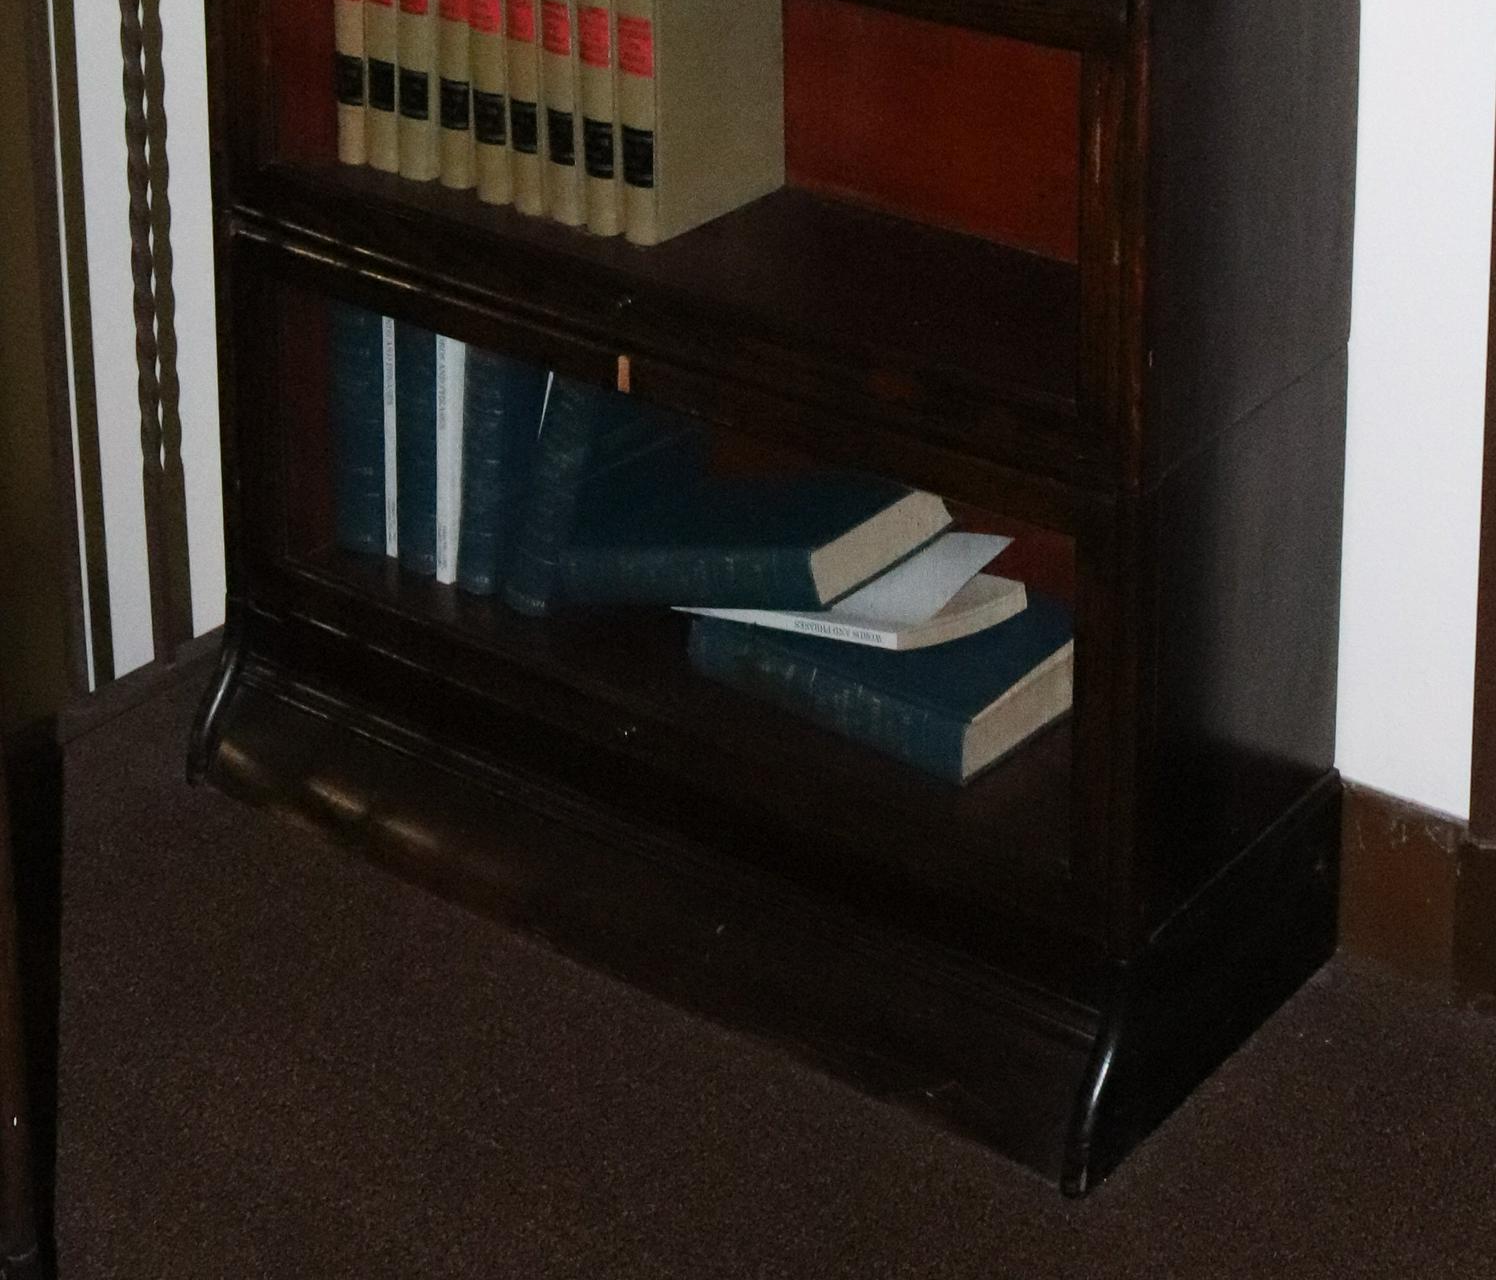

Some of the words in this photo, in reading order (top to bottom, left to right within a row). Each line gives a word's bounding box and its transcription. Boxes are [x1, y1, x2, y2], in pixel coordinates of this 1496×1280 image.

[794, 621, 831, 633] PHRASES
[832, 627, 851, 638] AND
[854, 629, 883, 643] WORDS
